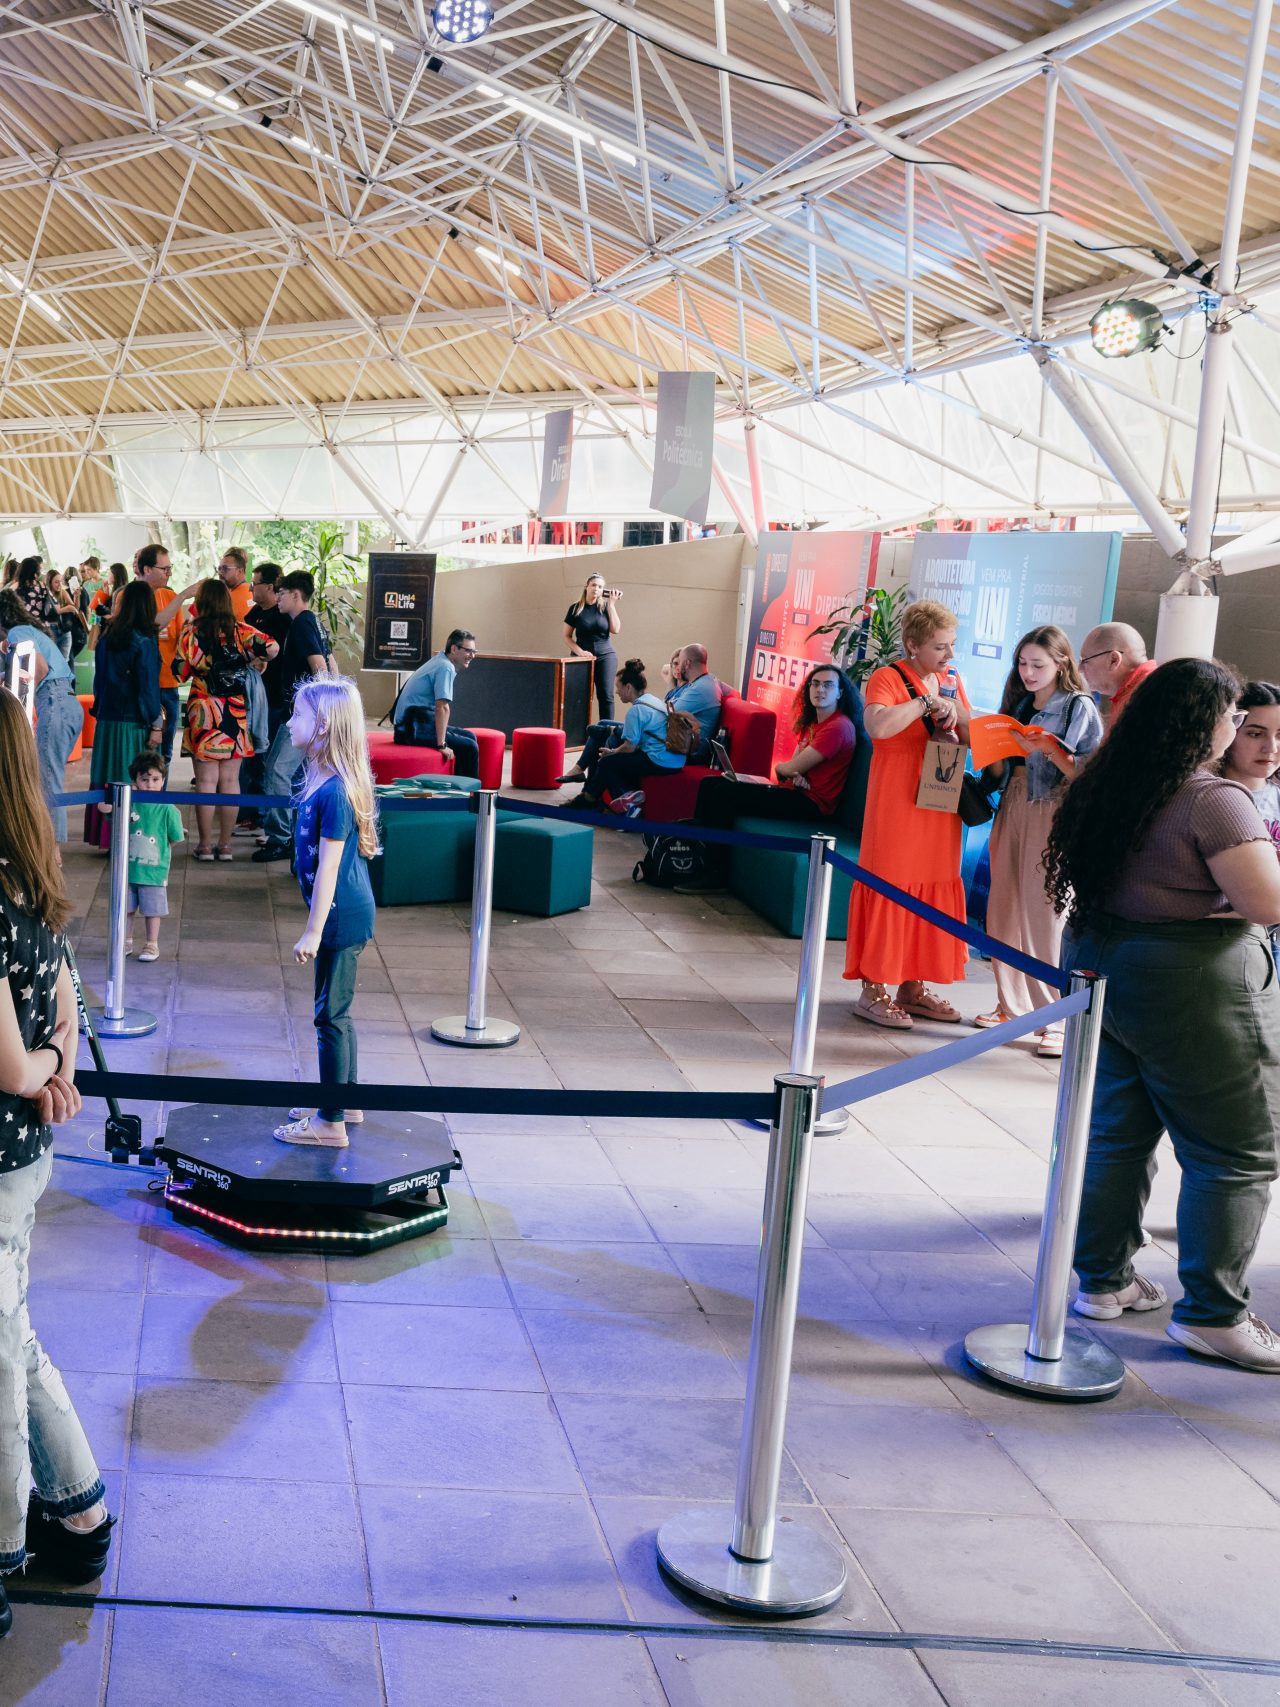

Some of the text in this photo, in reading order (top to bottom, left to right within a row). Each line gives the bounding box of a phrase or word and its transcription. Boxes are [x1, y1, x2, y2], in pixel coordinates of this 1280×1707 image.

[663, 440, 703, 468] Politécnica
[924, 558, 976, 586] ARQUITETURA
[981, 567, 1012, 583] VEM PRA
[398, 593, 416, 602] Uni4
[793, 568, 816, 611] UNI
[1015, 553, 1031, 627] INDUSTRIAL
[398, 601, 415, 609] Life
[974, 585, 1010, 642] UNI
[779, 599, 789, 649] DIREITO
[759, 631, 775, 647] DIREITO
[923, 783, 957, 793] UNISINOS
[70, 968, 81, 984] 360
[177, 1157, 232, 1184] SENTRIO
[217, 1179, 229, 1190] 360
[385, 1171, 441, 1195] SENTRIO
[426, 1179, 438, 1188] 360
